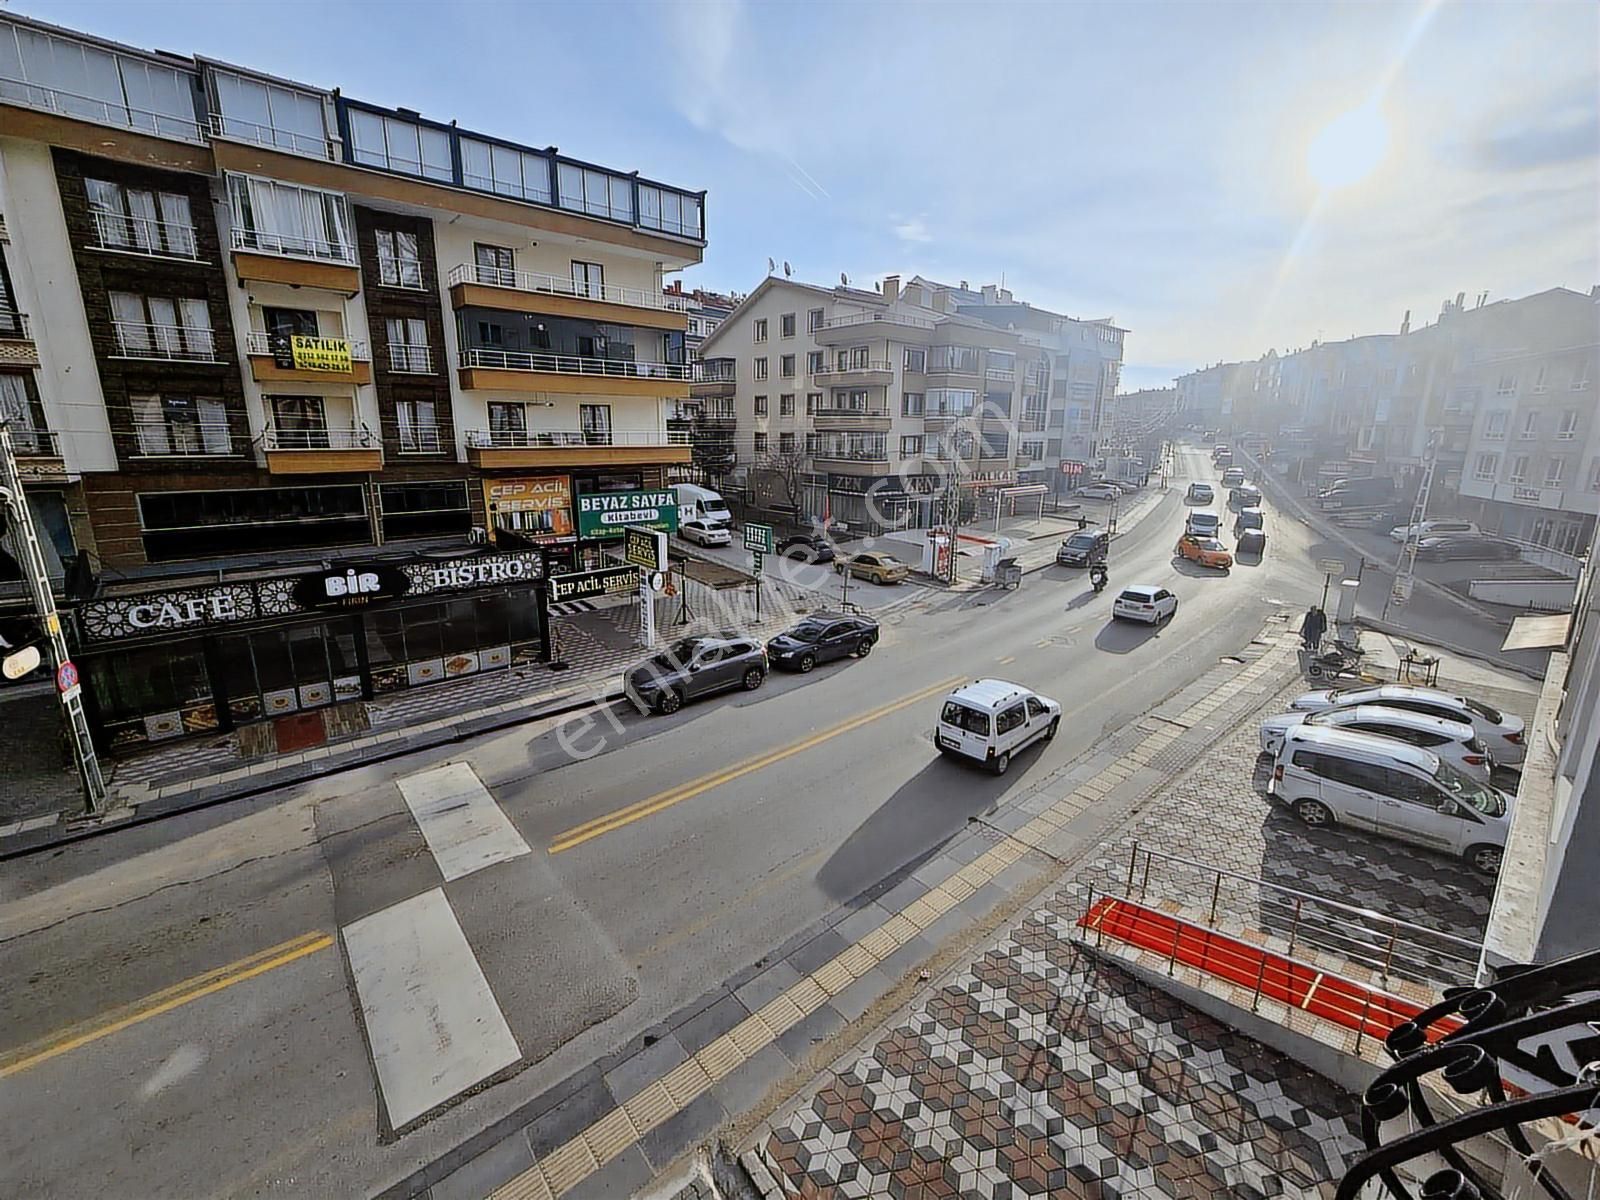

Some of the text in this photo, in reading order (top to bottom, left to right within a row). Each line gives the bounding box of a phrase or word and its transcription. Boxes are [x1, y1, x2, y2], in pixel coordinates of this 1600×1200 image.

[295, 338, 347, 352] SATILIK
[490, 484, 526, 496] CEP
[531, 480, 564, 494] ACİL
[835, 476, 863, 491] ZEN
[904, 476, 936, 493] ZEN
[499, 495, 563, 512] SERVİS
[581, 493, 675, 512] BEYAZ SAYFA
[607, 512, 653, 522] Kitabevi
[325, 569, 381, 596] BİR
[433, 560, 524, 588] BISTRO
[577, 576, 601, 592] ACİL
[603, 570, 639, 587] SERVİS
[128, 595, 236, 628] CAFE
